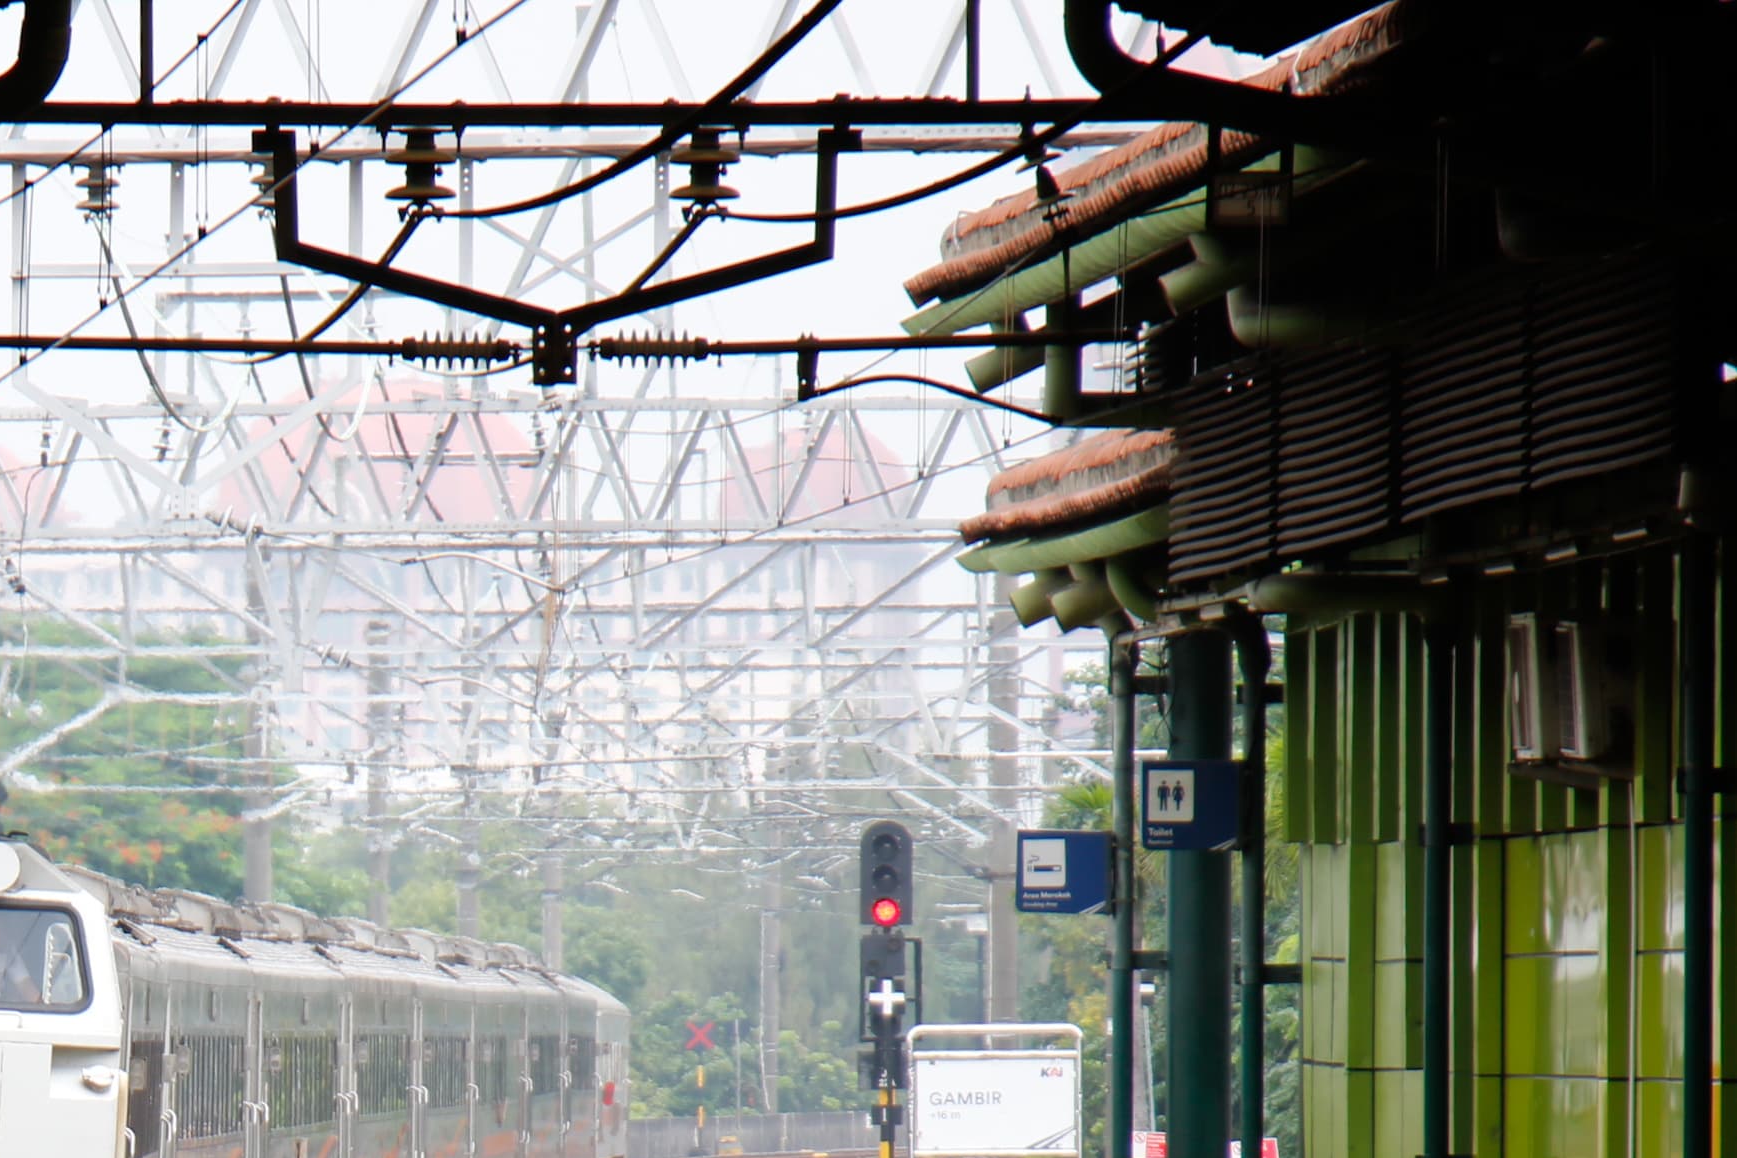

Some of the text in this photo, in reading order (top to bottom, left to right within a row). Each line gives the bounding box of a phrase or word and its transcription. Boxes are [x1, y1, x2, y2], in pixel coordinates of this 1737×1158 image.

[1147, 828, 1173, 836] Toilet
[1040, 1067, 1063, 1077] KAI
[929, 1091, 1003, 1106] GAMBIR
